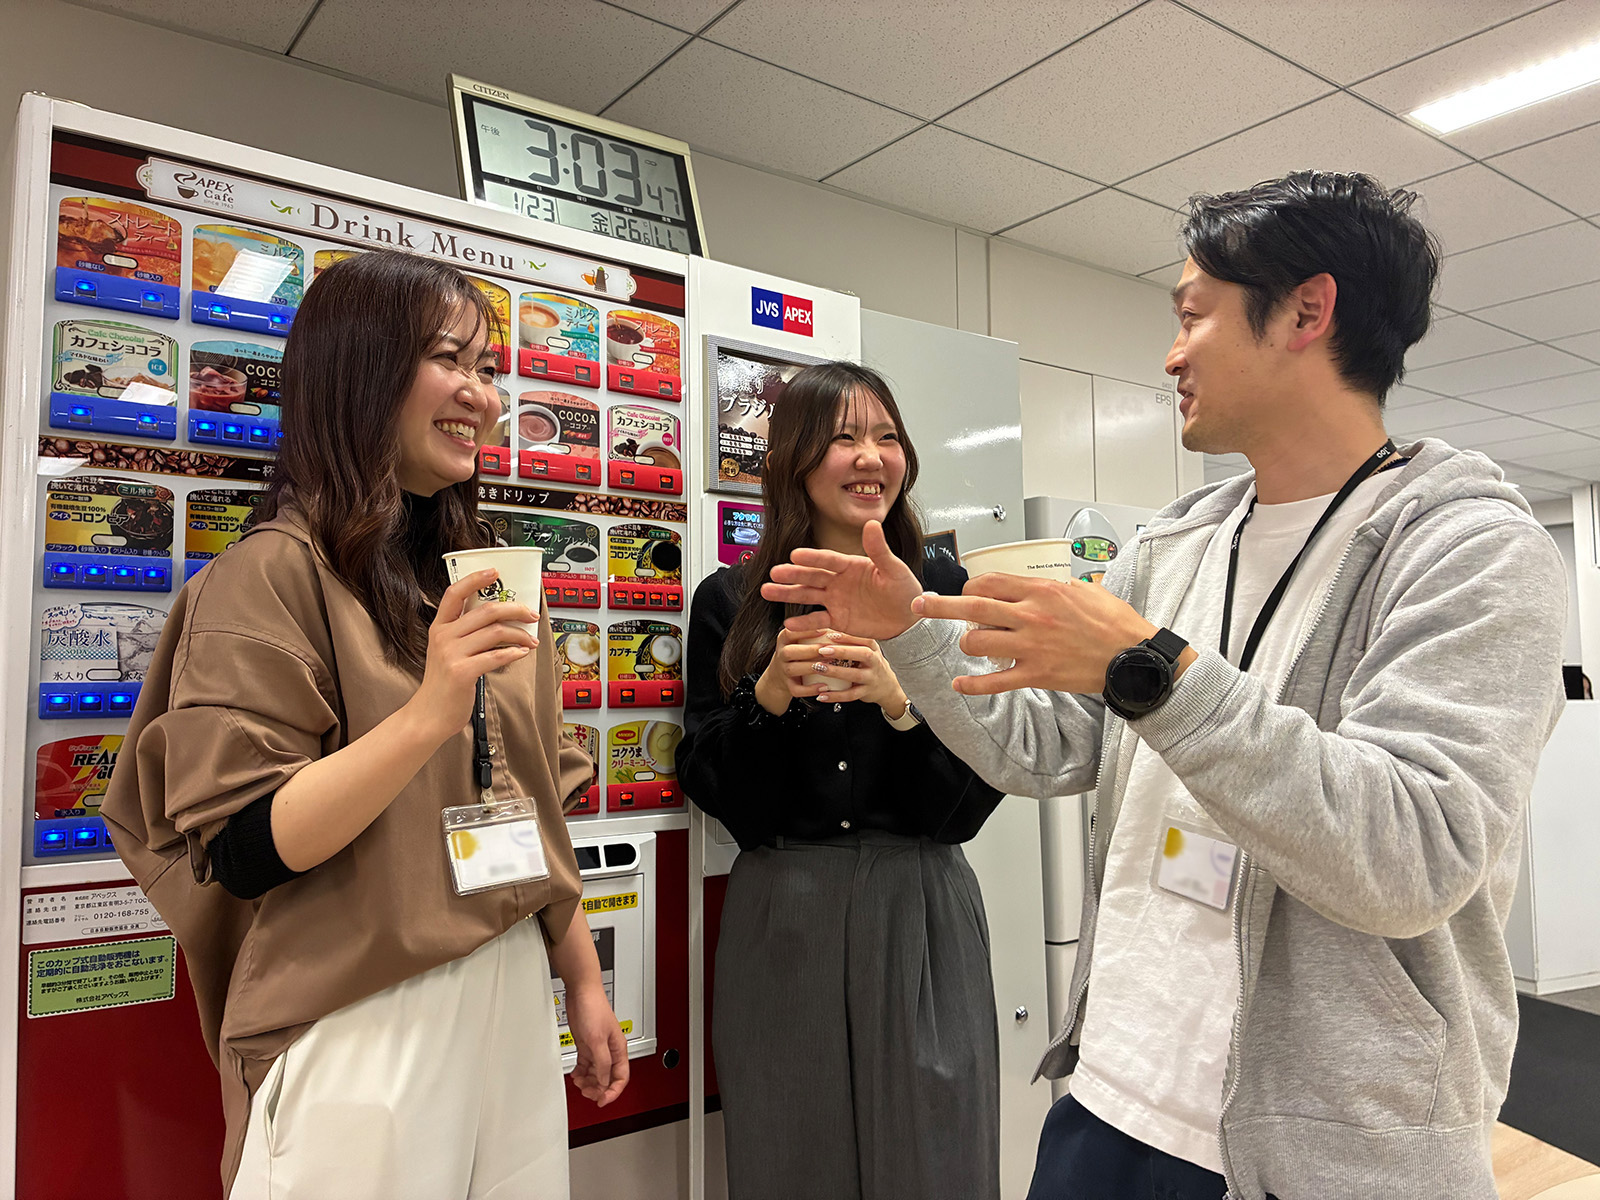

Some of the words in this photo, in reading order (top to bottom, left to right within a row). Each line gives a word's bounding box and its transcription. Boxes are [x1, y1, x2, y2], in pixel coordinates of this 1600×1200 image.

[473, 84, 509, 100] CITIZEN
[480, 123, 500, 137] 午後
[524, 119, 643, 207] 3:03
[195, 177, 234, 193] APEX
[204, 189, 234, 203] Cafe
[647, 184, 679, 216] 47
[513, 191, 555, 223] 1/23
[109, 211, 176, 237] ストレート
[591, 211, 610, 235] 金
[134, 231, 166, 244] ティー
[311, 202, 416, 249] Drink
[430, 231, 514, 270] Menu
[566, 307, 595, 322] ミルク
[756, 300, 779, 317] JVS
[784, 306, 812, 325] APEX
[566, 320, 587, 329] ティー
[635, 320, 676, 338] ストレート
[70, 335, 161, 357] カフェショコラ
[151, 363, 164, 371] ICE
[1155, 393, 1172, 407] EPS
[559, 410, 597, 424] COCOA
[617, 416, 670, 432] カフェショコラ
[50, 482, 98, 493] 挽いて淹れる
[121, 487, 154, 497] ミル挽き
[71, 512, 130, 525] コロンビア
[190, 521, 208, 529] アイス
[80, 545, 107, 554] 砂糖入り
[47, 629, 111, 647] 炭酸水
[53, 671, 84, 681] 氷入り
[612, 746, 643, 758] コクうま
[611, 758, 657, 769] クリーミーコーン
[27, 896, 66, 905] 管理者名
[26, 905, 66, 914] 連絡先住所
[26, 917, 66, 926] 連絡先電話番号
[94, 909, 149, 920] 0120-168-755
[36, 954, 169, 979] 定期的に自動洗浄をおこないます。
[37, 950, 140, 970] このカップ式自動販売機は
